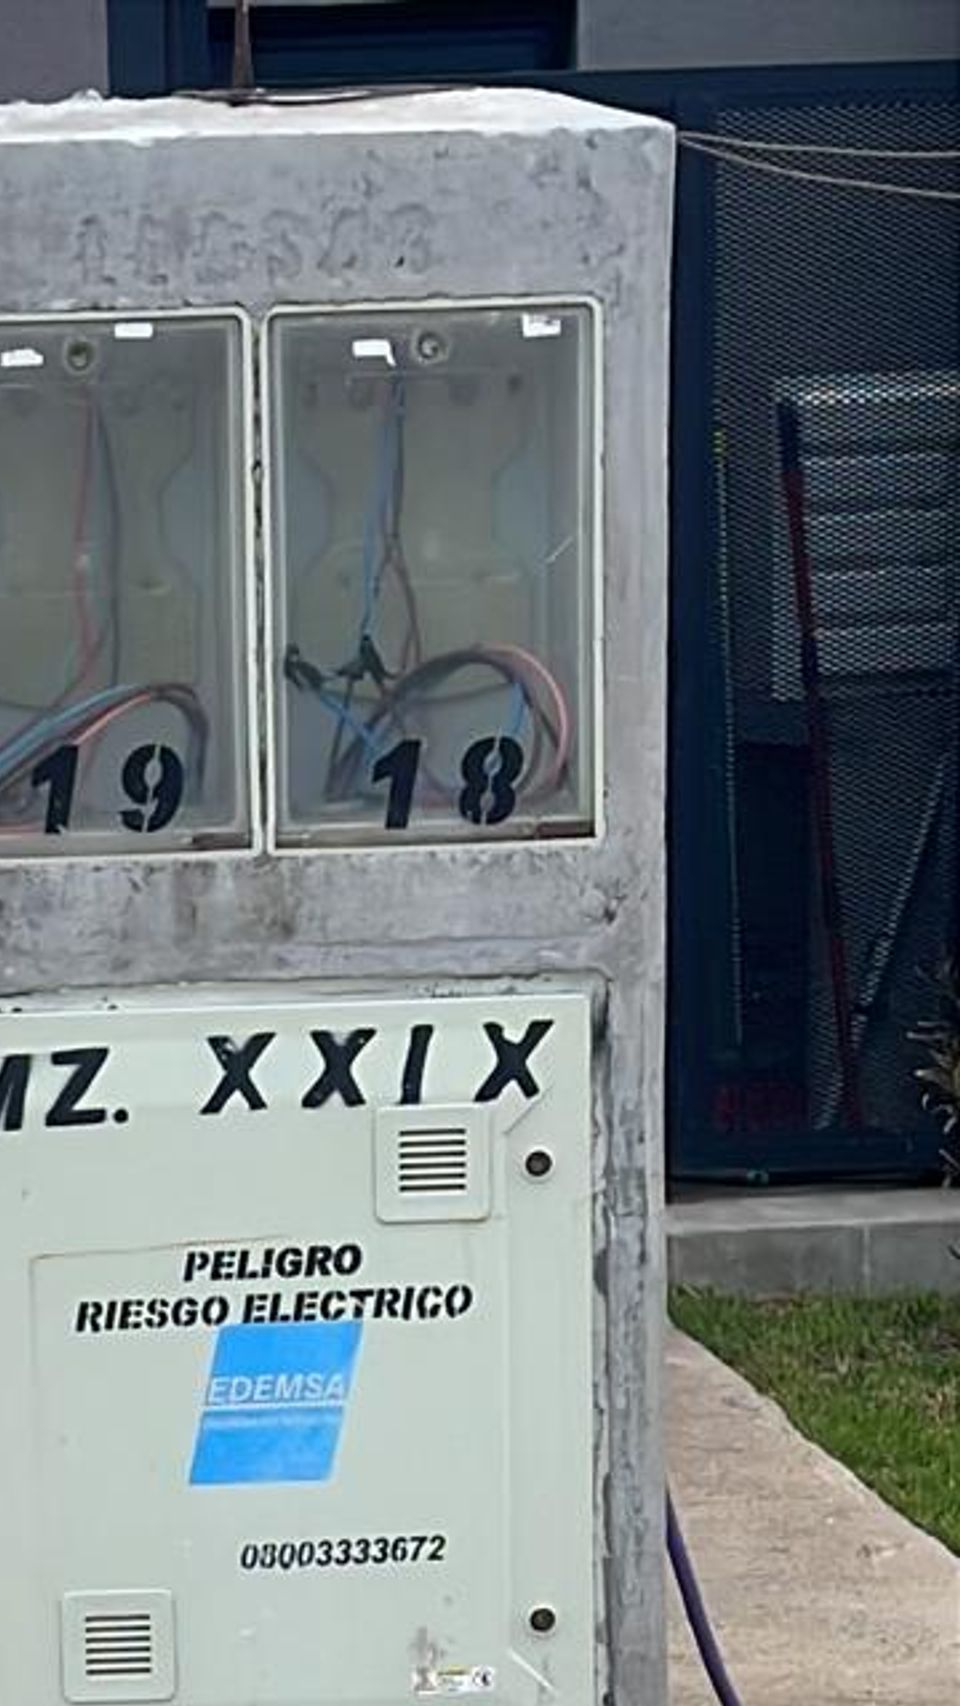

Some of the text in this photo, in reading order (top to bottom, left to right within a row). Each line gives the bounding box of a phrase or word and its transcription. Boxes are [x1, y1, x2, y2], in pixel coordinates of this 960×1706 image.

[30, 744, 184, 835] 19
[371, 735, 525, 830] 18
[183, 1244, 363, 1282] PELIGRO
[76, 1284, 474, 1333] RIESGO ELECTRICO
[208, 1372, 347, 1402] EDEMSA
[240, 1534, 447, 1571] 08003333672
